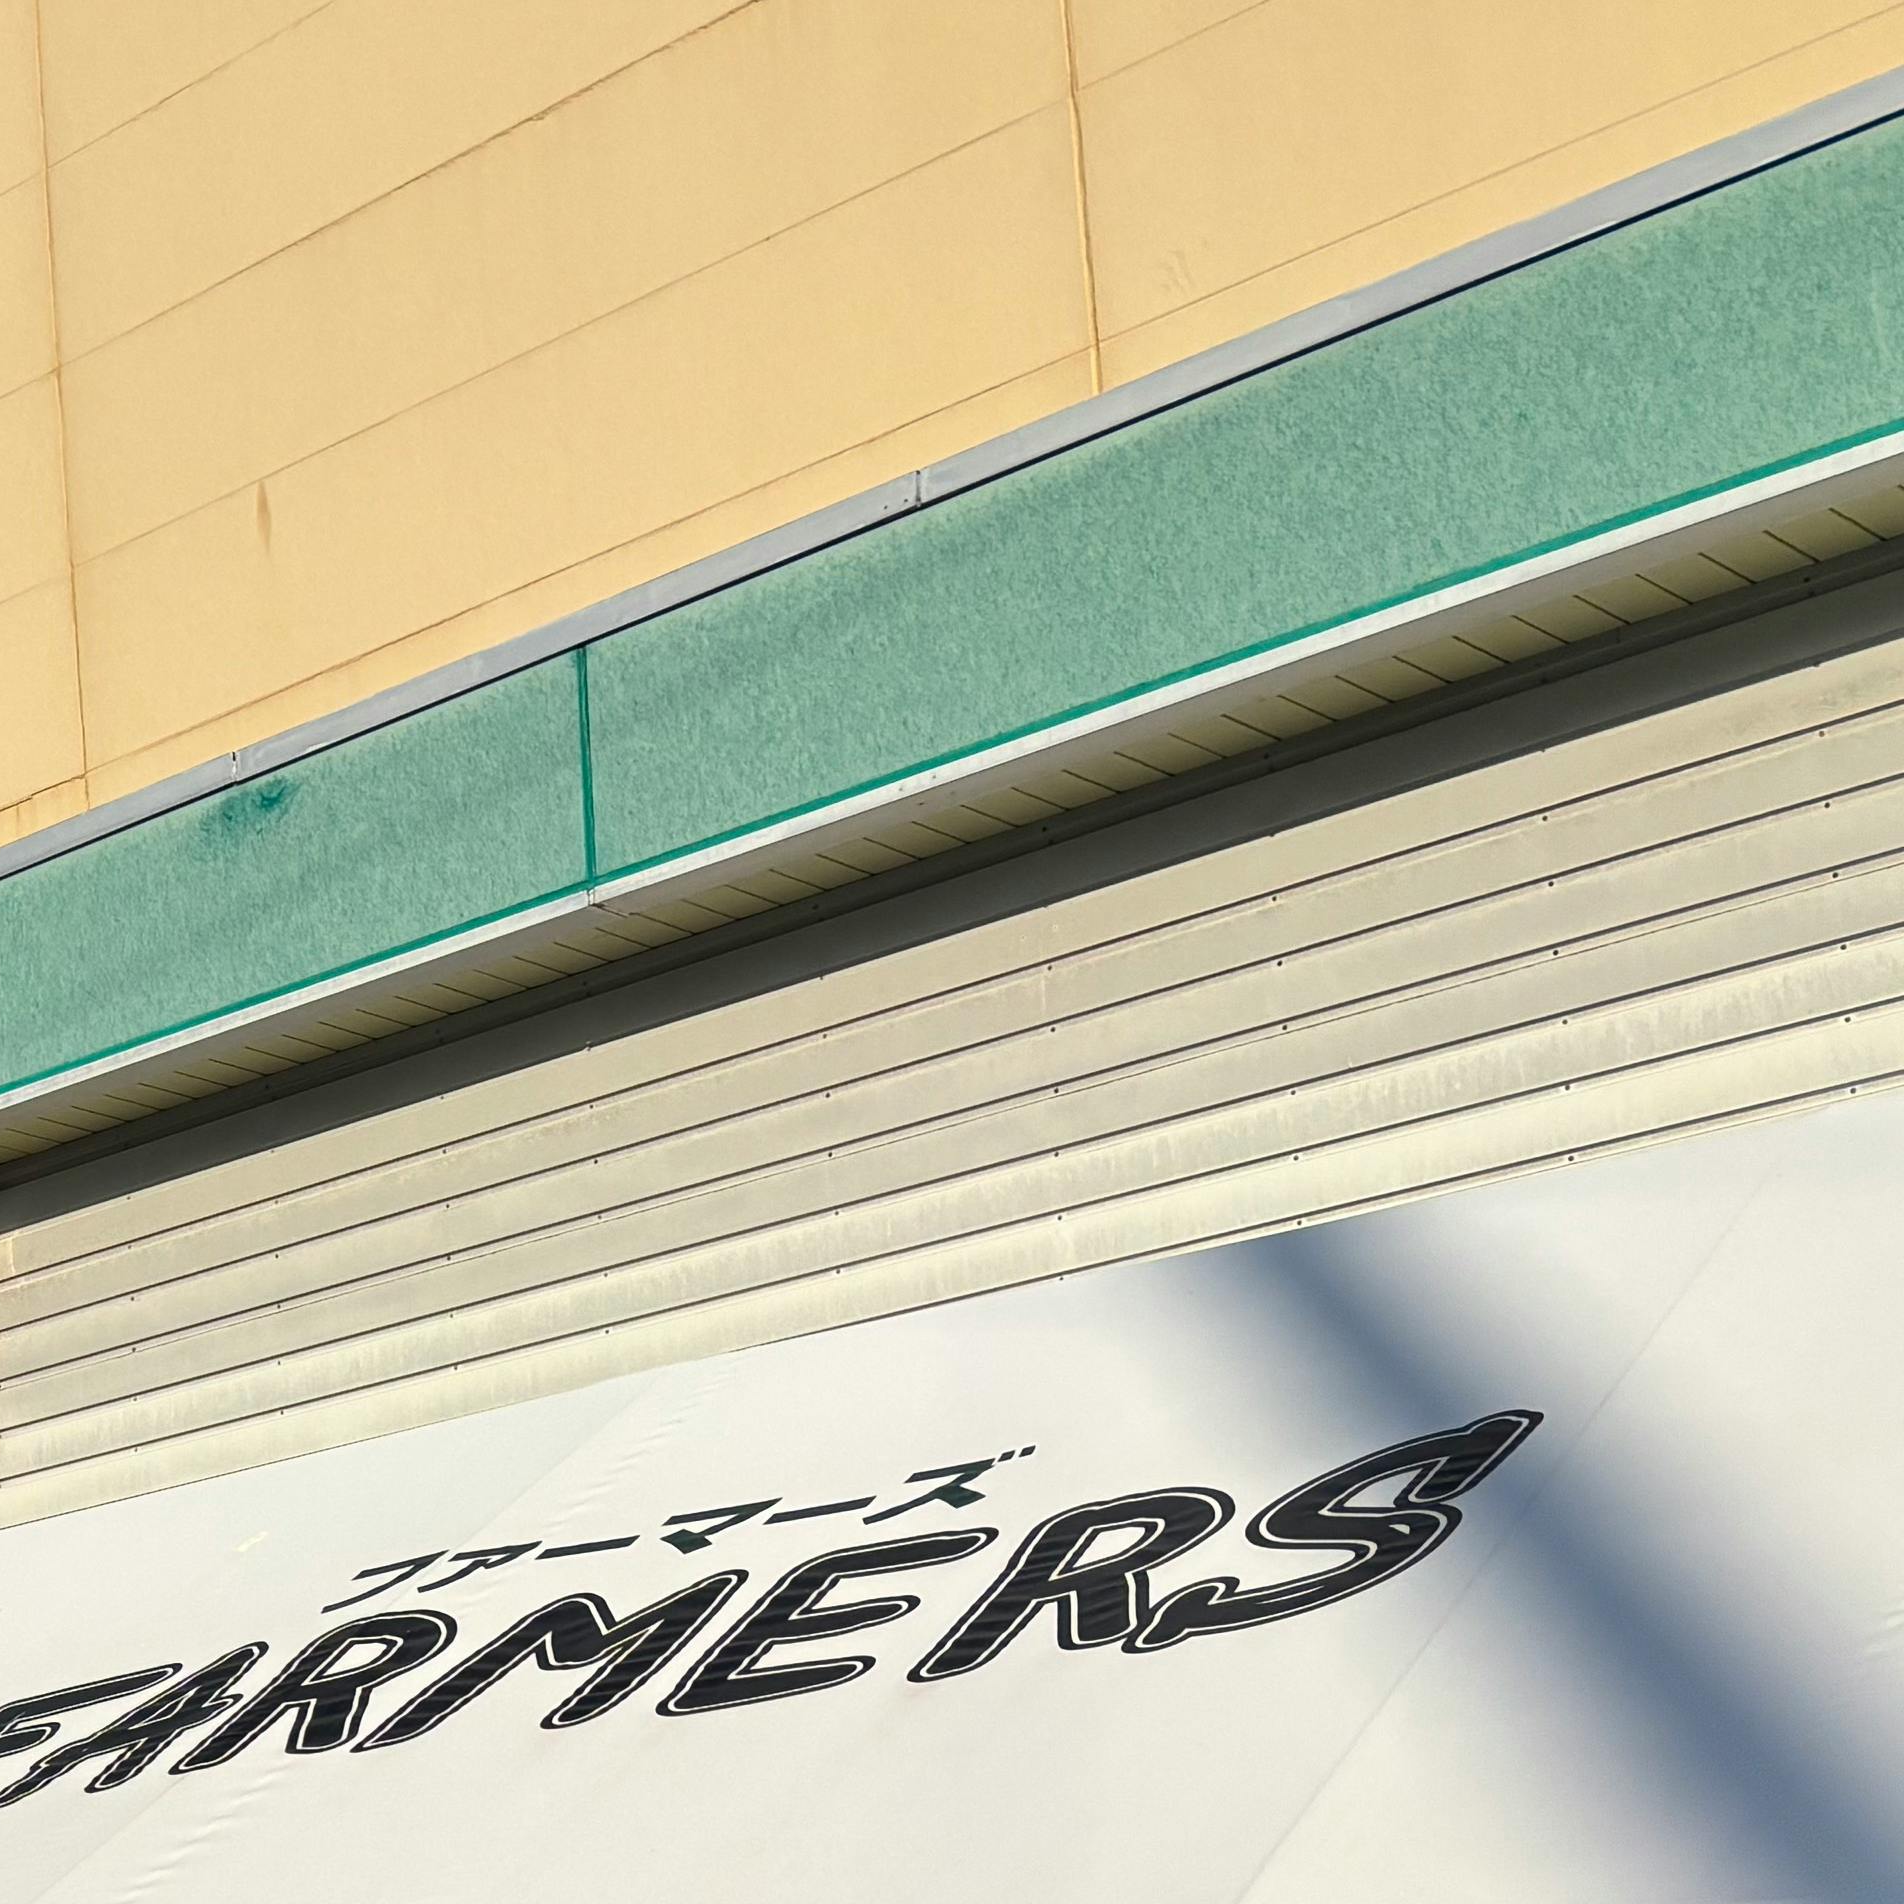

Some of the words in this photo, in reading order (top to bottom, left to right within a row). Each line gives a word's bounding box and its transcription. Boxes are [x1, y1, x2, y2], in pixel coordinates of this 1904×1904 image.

[321, 1446, 1035, 1613] ファーマーズ
